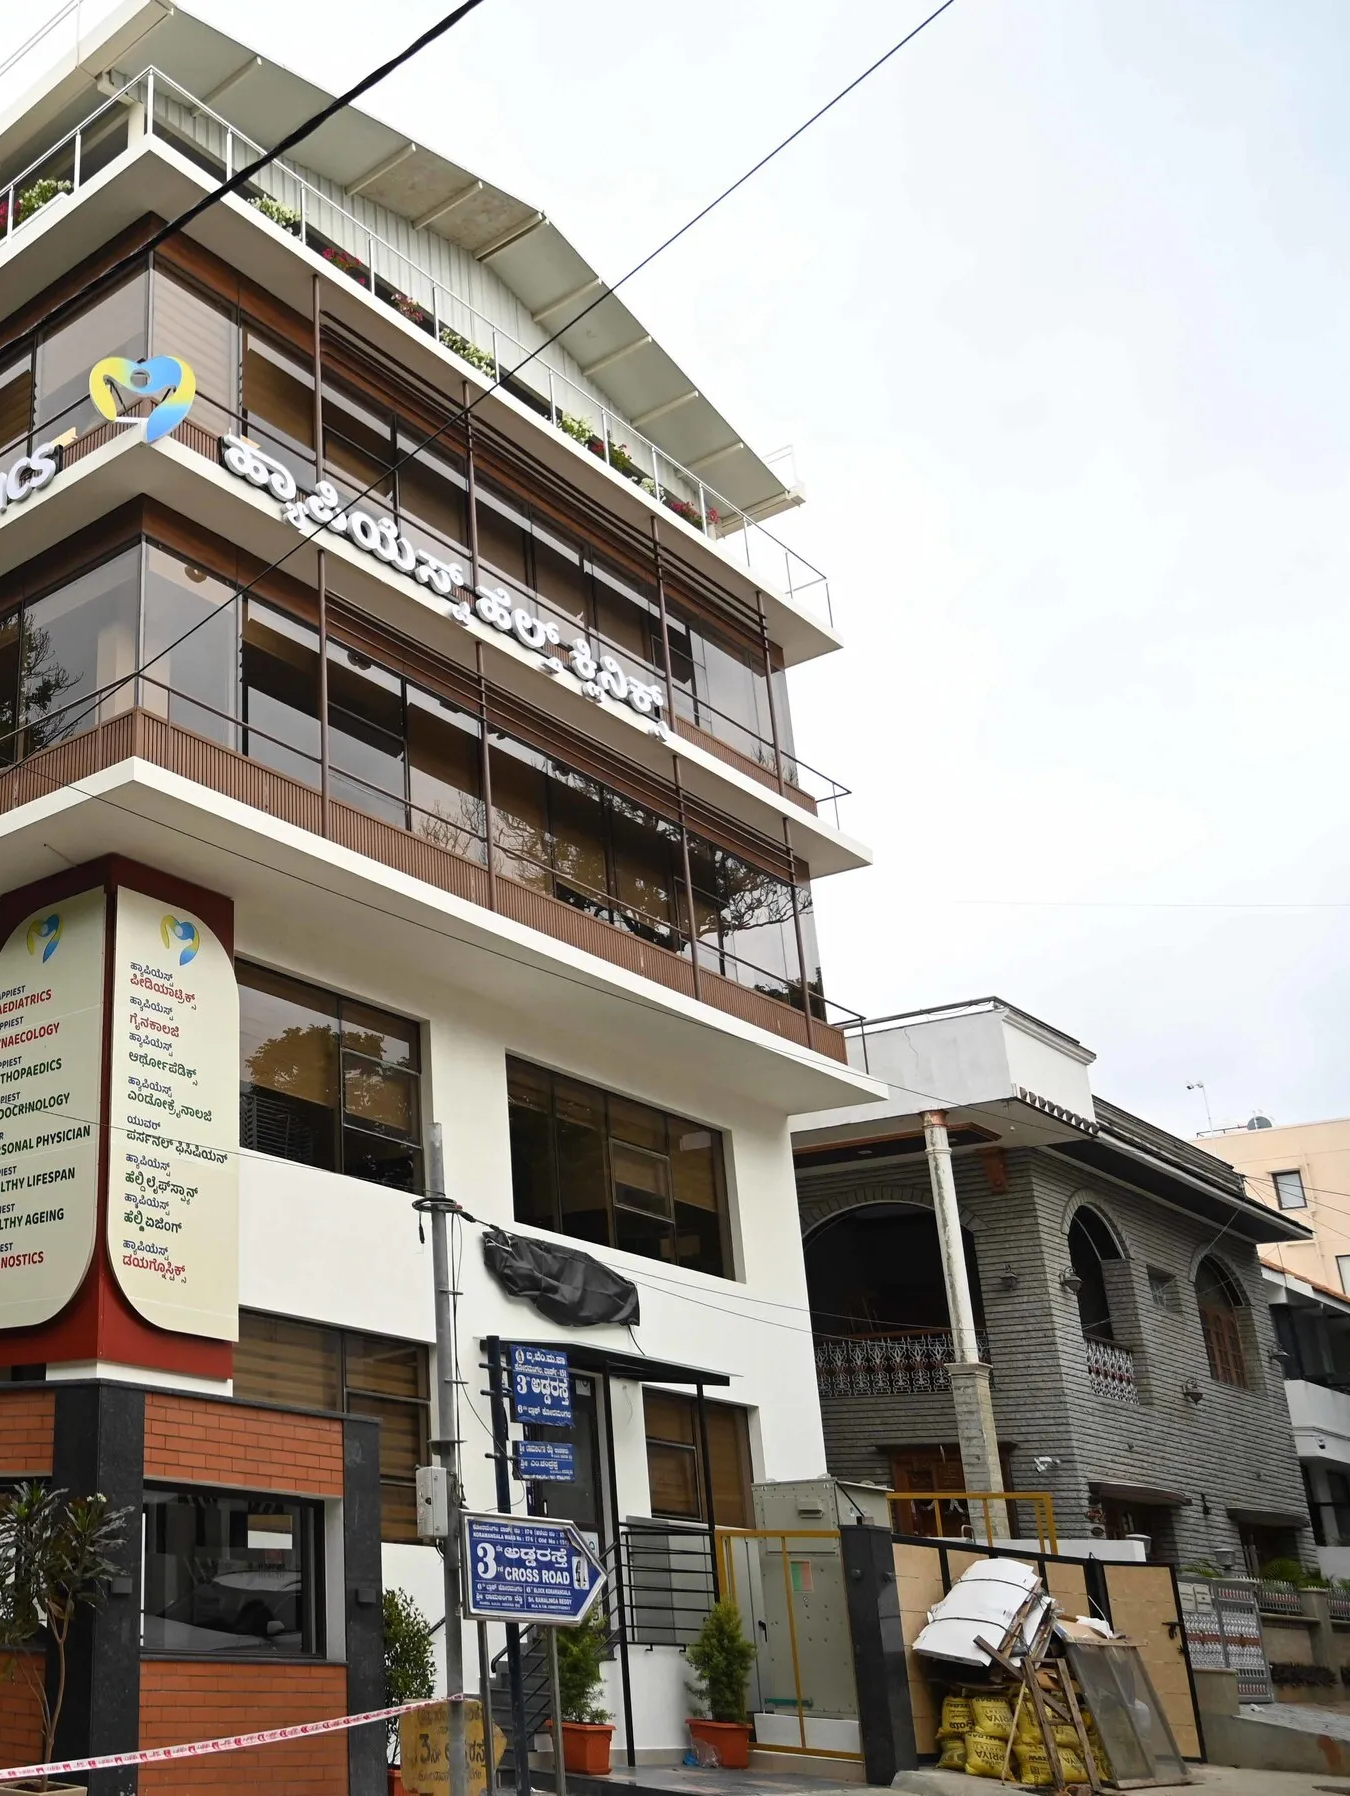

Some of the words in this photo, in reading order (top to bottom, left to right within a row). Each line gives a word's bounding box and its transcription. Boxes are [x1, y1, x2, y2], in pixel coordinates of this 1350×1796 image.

[130, 961, 174, 987] ಹ್ಯಾಪಿಯೆಸ್ಟ್
[129, 996, 174, 1021] ಹ್ಯಾಪಿಯೆಸ್ಟ್
[128, 1032, 173, 1057] ಹ್ಯಾಪಿಯೆಸ್ಟ್
[126, 1115, 161, 1130] ಯುವರ್
[35, 1125, 91, 1148] PHYSICIAN
[125, 1153, 171, 1177] ಹ್ಯಾಪಿಯೆಸ್ಟ್
[26, 1167, 75, 1188] LIFESPAN
[24, 1208, 64, 1226] AGEING
[122, 1239, 169, 1261] ಹ್ಯಾಪಿಯೆಸ್ಟ್
[504, 1545, 568, 1568] ಅಡ್ಡರಸ್ತೆ
[504, 1566, 539, 1583] CROSS
[542, 1569, 570, 1585] ROAD
